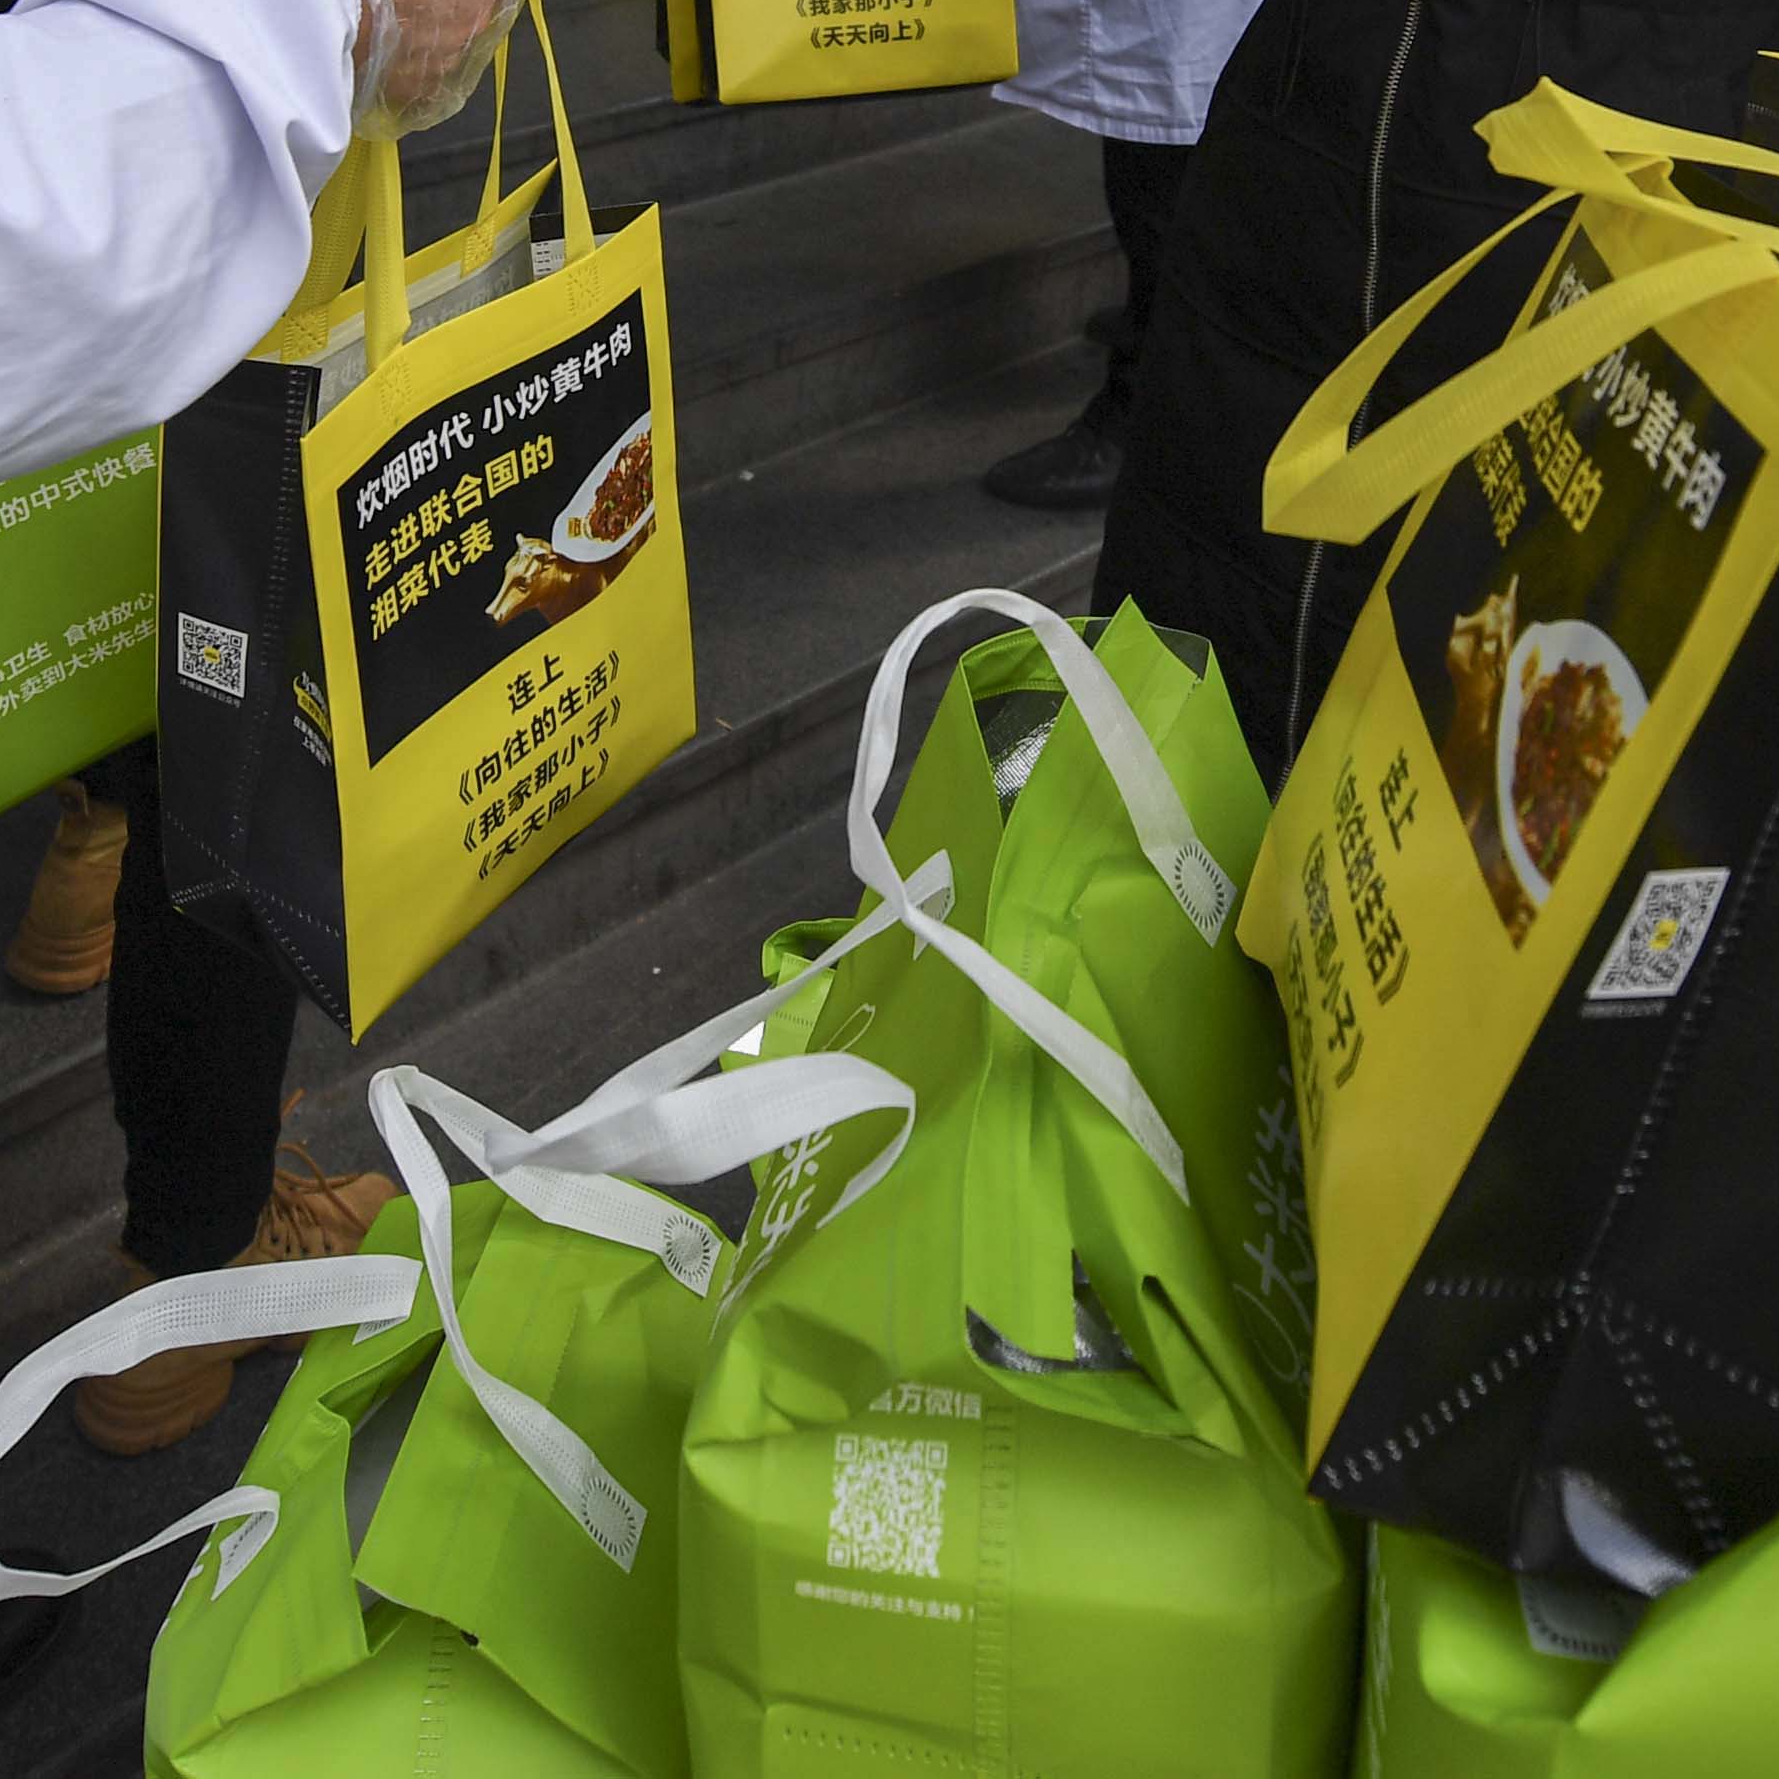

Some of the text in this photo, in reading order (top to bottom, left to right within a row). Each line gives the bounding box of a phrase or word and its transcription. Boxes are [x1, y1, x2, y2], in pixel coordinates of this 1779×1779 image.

[810, 22, 926, 50] 《天天向上》
[356, 412, 474, 529] 炊烟时代
[482, 322, 632, 434] 小炒黄牛肉
[365, 434, 554, 591] 走进联合国的
[63, 592, 155, 647] 食材放心
[369, 518, 494, 641] 湘菜代表
[459, 650, 620, 806] 《向往的生活》
[507, 654, 564, 715] 连上
[463, 695, 621, 853] 《我家那小子》
[478, 748, 609, 881] 《天天向上》
[1379, 747, 1419, 852] 连上
